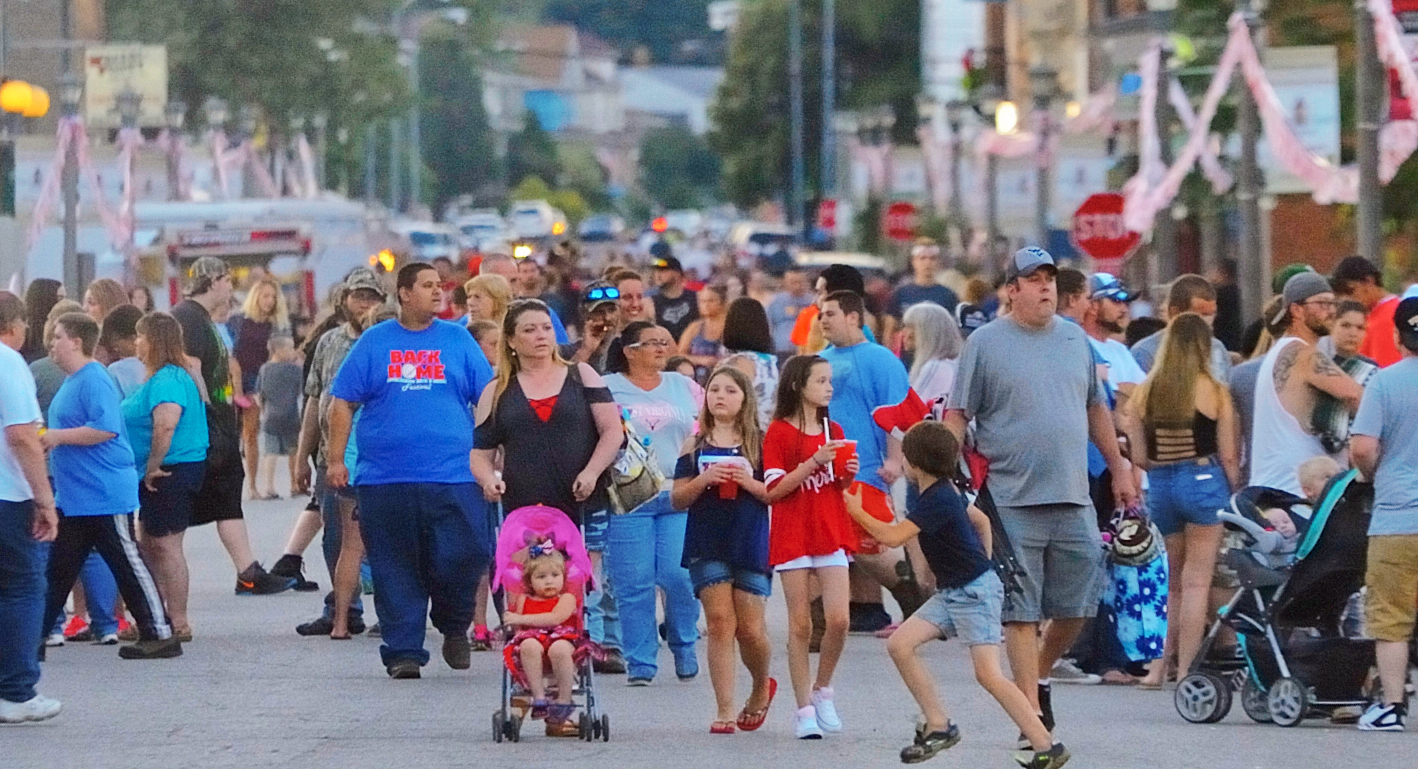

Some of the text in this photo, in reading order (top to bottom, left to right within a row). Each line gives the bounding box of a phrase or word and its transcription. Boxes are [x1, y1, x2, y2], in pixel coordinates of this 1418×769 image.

[1077, 213, 1125, 239] STO
[389, 350, 441, 364] BACK
[387, 364, 446, 380] HOME
